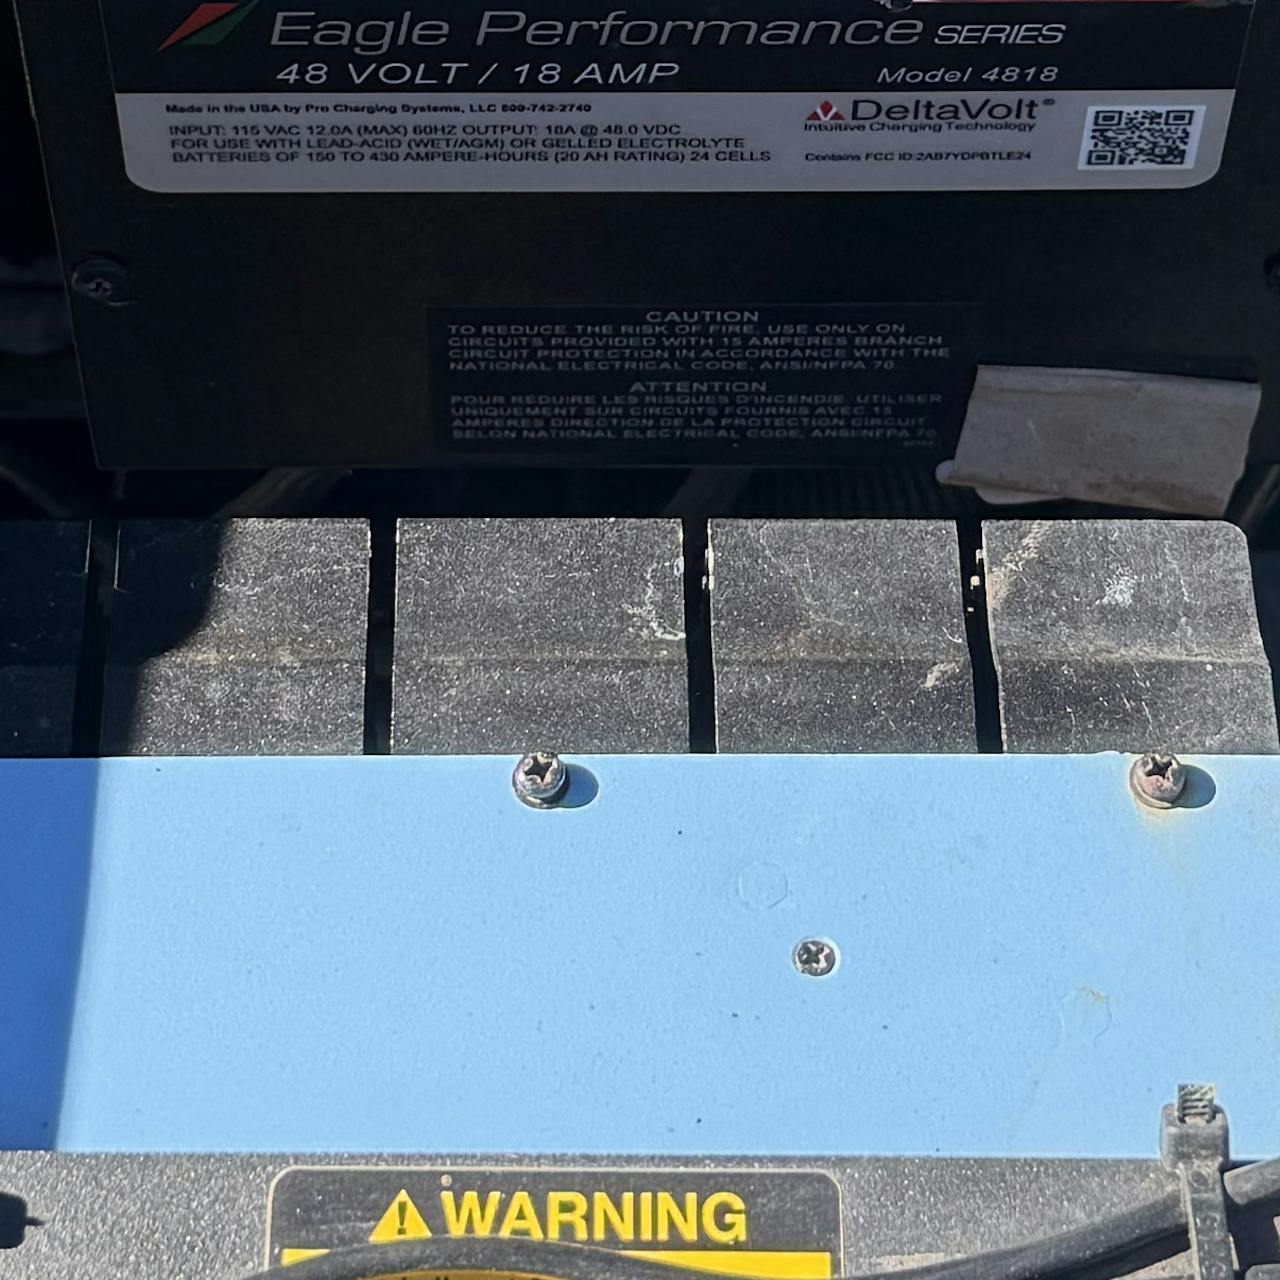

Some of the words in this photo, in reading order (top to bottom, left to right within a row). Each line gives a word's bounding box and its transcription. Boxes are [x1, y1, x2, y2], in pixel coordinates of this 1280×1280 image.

[270, 11, 450, 56] Eagle
[476, 11, 924, 45] Performance
[934, 24, 1067, 44] SERIES
[276, 63, 328, 85] 48
[347, 63, 469, 84] VOLT
[477, 63, 499, 84] /
[514, 63, 562, 84] 18
[573, 63, 680, 84] AMP
[877, 67, 973, 83] Model
[981, 66, 1059, 82] 4818
[166, 104, 202, 113] Made
[207, 104, 220, 113] in
[224, 104, 245, 113] the
[249, 104, 281, 113] USA
[284, 104, 301, 114] by
[305, 104, 329, 113] Pro
[333, 104, 397, 114] Charging
[401, 104, 465, 114] Systems,
[169, 124, 226, 136] INPUT:
[233, 124, 260, 136] 115
[263, 124, 300, 136] VAC
[307, 124, 353, 136] 12.0A
[356, 124, 408, 136] (MAX)
[643, 124, 681, 136] VDC
[804, 122, 866, 132] Intuitive
[869, 122, 943, 132] Charging
[947, 122, 1036, 132] Technology
[170, 138, 208, 149] FOR
[214, 138, 250, 149] USE
[256, 138, 301, 149] WITH
[306, 138, 402, 149] LEAD-ACID
[407, 138, 505, 149] (WET/AGM)
[510, 138, 536, 149] OR
[542, 138, 612, 149] GELLED
[617, 138, 744, 149] ELECTROLYTE
[173, 151, 270, 163] BATTERIES
[276, 151, 300, 163] OF
[342, 151, 365, 163] TO
[404, 151, 549, 163] AMPERE-HOURS
[583, 151, 608, 163] AH
[614, 151, 685, 163] RATING)
[690, 151, 709, 163] 24
[715, 151, 771, 163] CELLS
[805, 151, 861, 161] Contains
[865, 151, 895, 161] FCC
[645, 310, 760, 323] CAUTION
[628, 381, 768, 394] ATTENTION
[439, 1191, 747, 1243] WARNING
